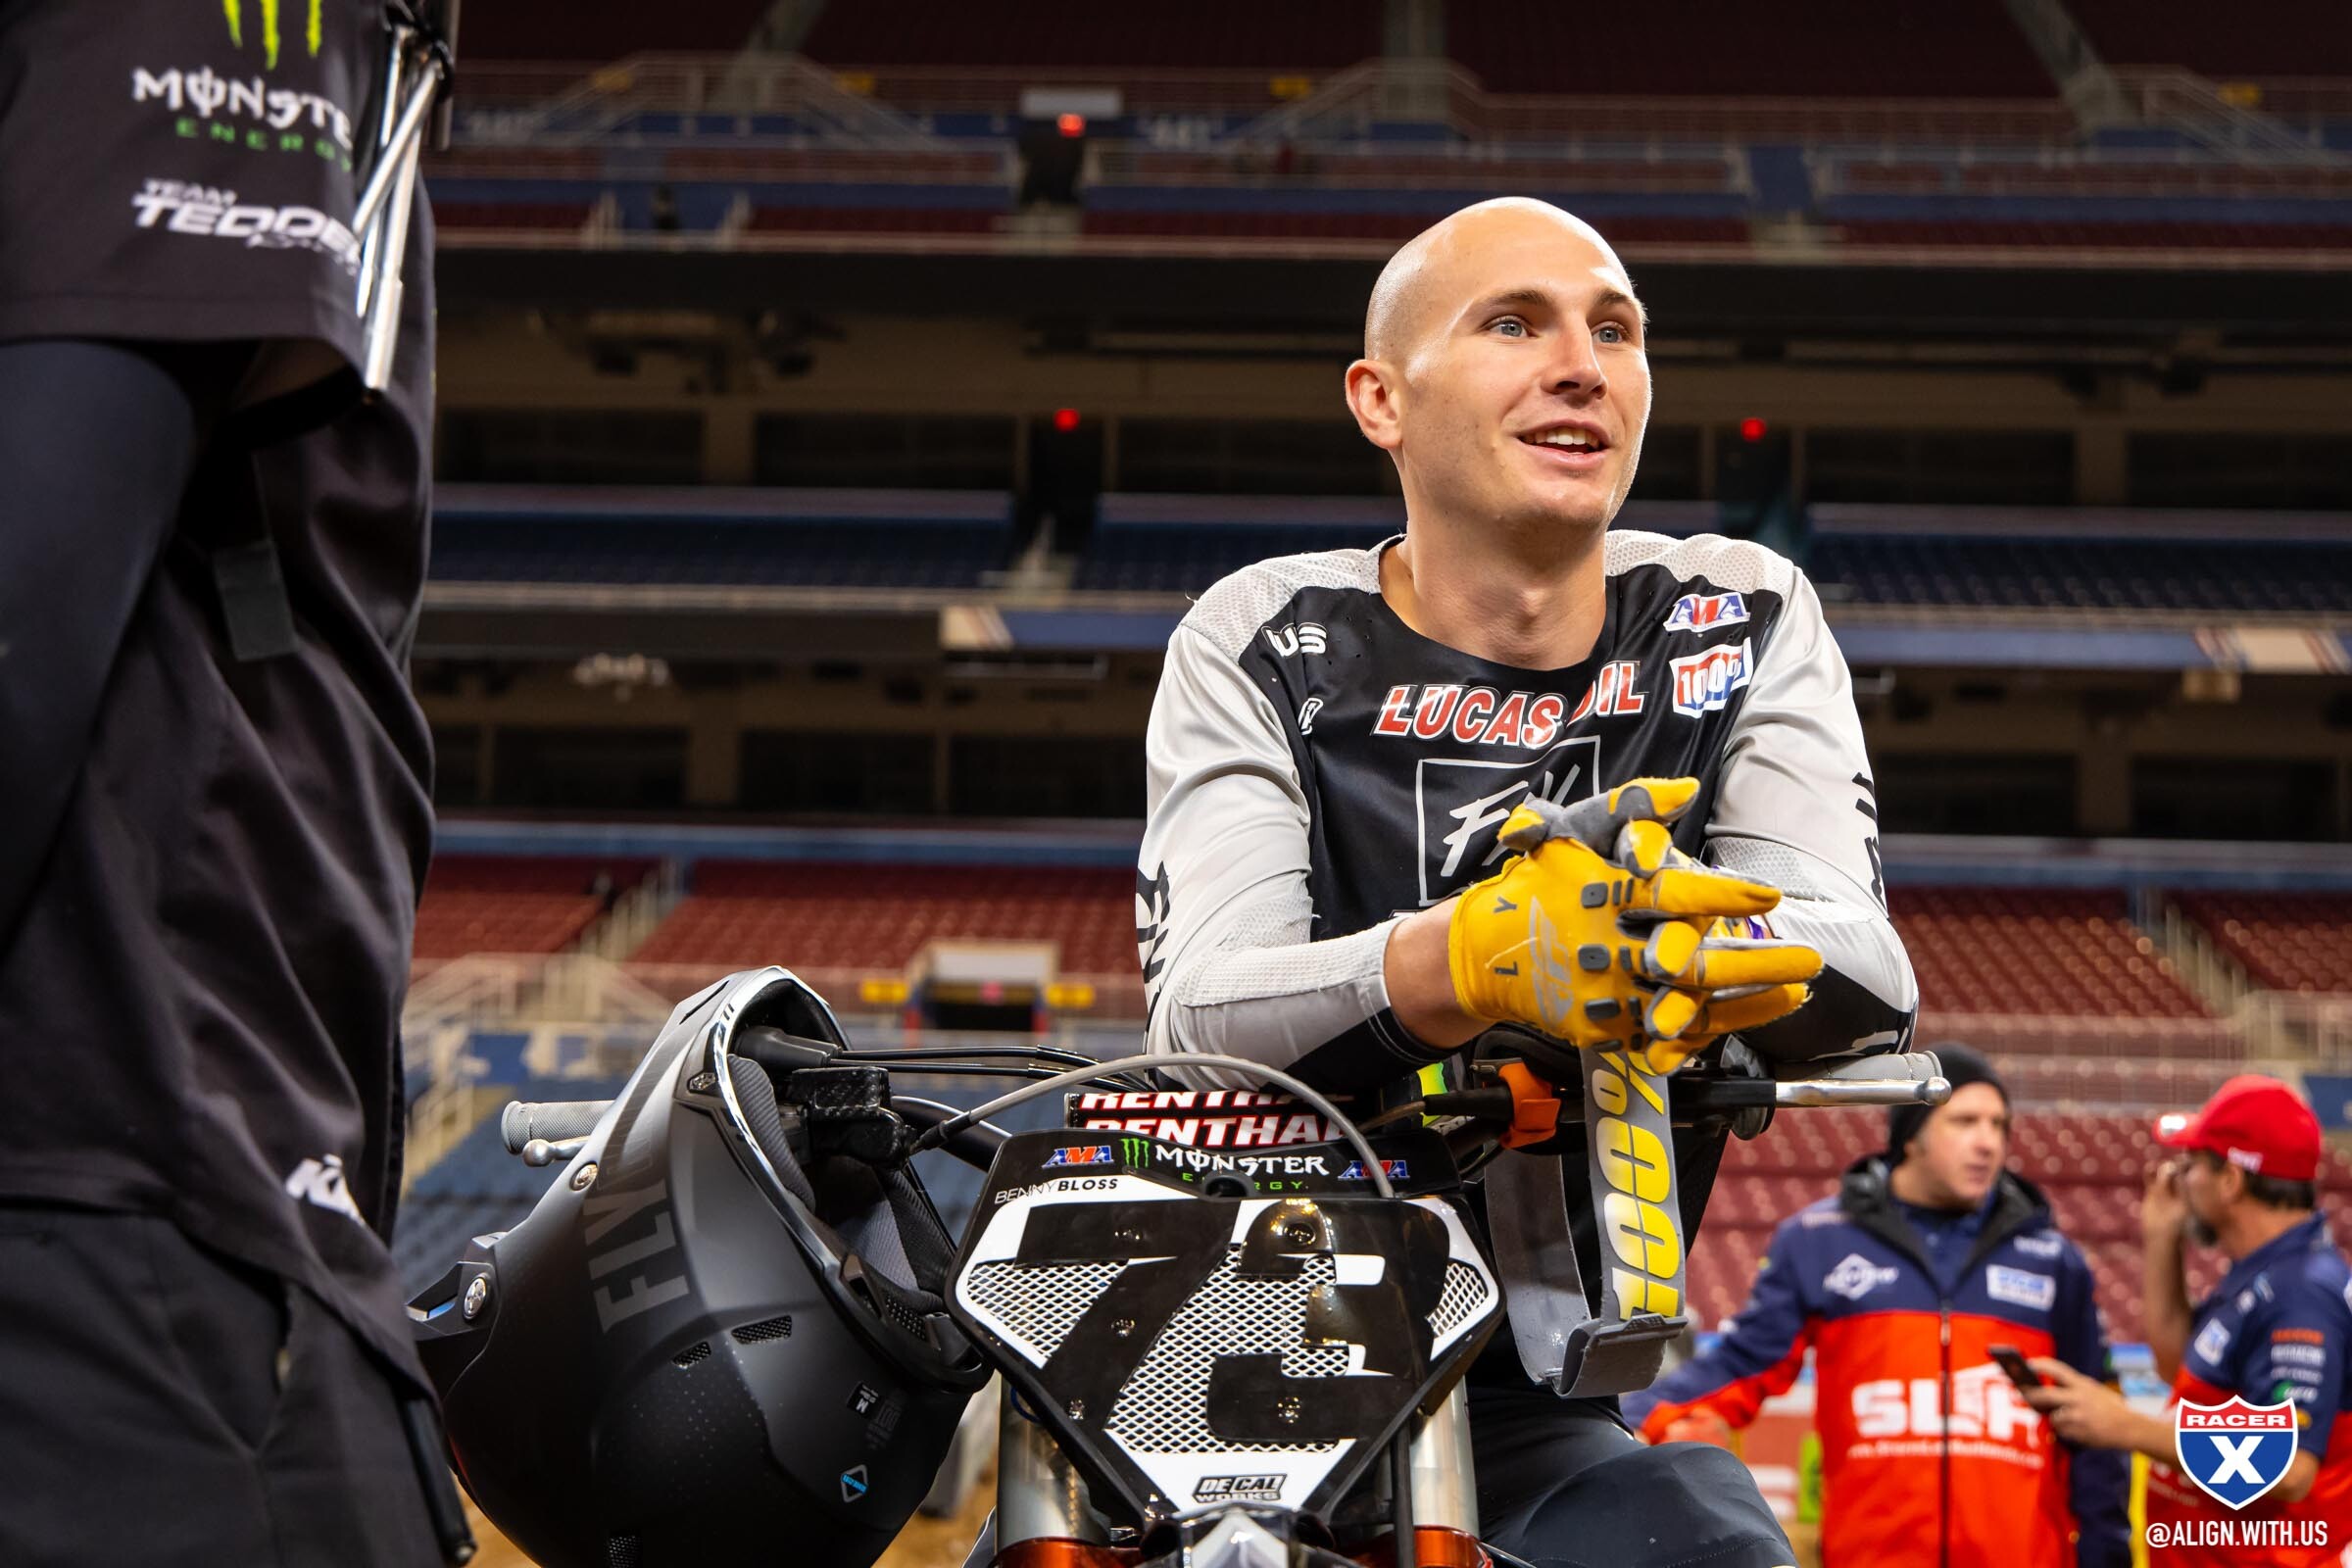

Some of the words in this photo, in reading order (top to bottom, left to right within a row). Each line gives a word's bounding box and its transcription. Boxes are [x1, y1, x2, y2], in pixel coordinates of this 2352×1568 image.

[1372, 685, 1564, 749] LUCAS
[1084, 1115, 1346, 1148] NTHAL
[1042, 1145, 1114, 1169] AMA
[1154, 1145, 1329, 1176] MONSTER
[995, 1181, 1056, 1204] BENNY
[1057, 1178, 1118, 1192] BLOSS
[1182, 1172, 1303, 1191] ERGY
[584, 1178, 690, 1335] FLY
[1013, 1198, 1450, 1446] 73
[1196, 1492, 1280, 1503] WORKS
[1199, 1477, 1279, 1494] DECAL
